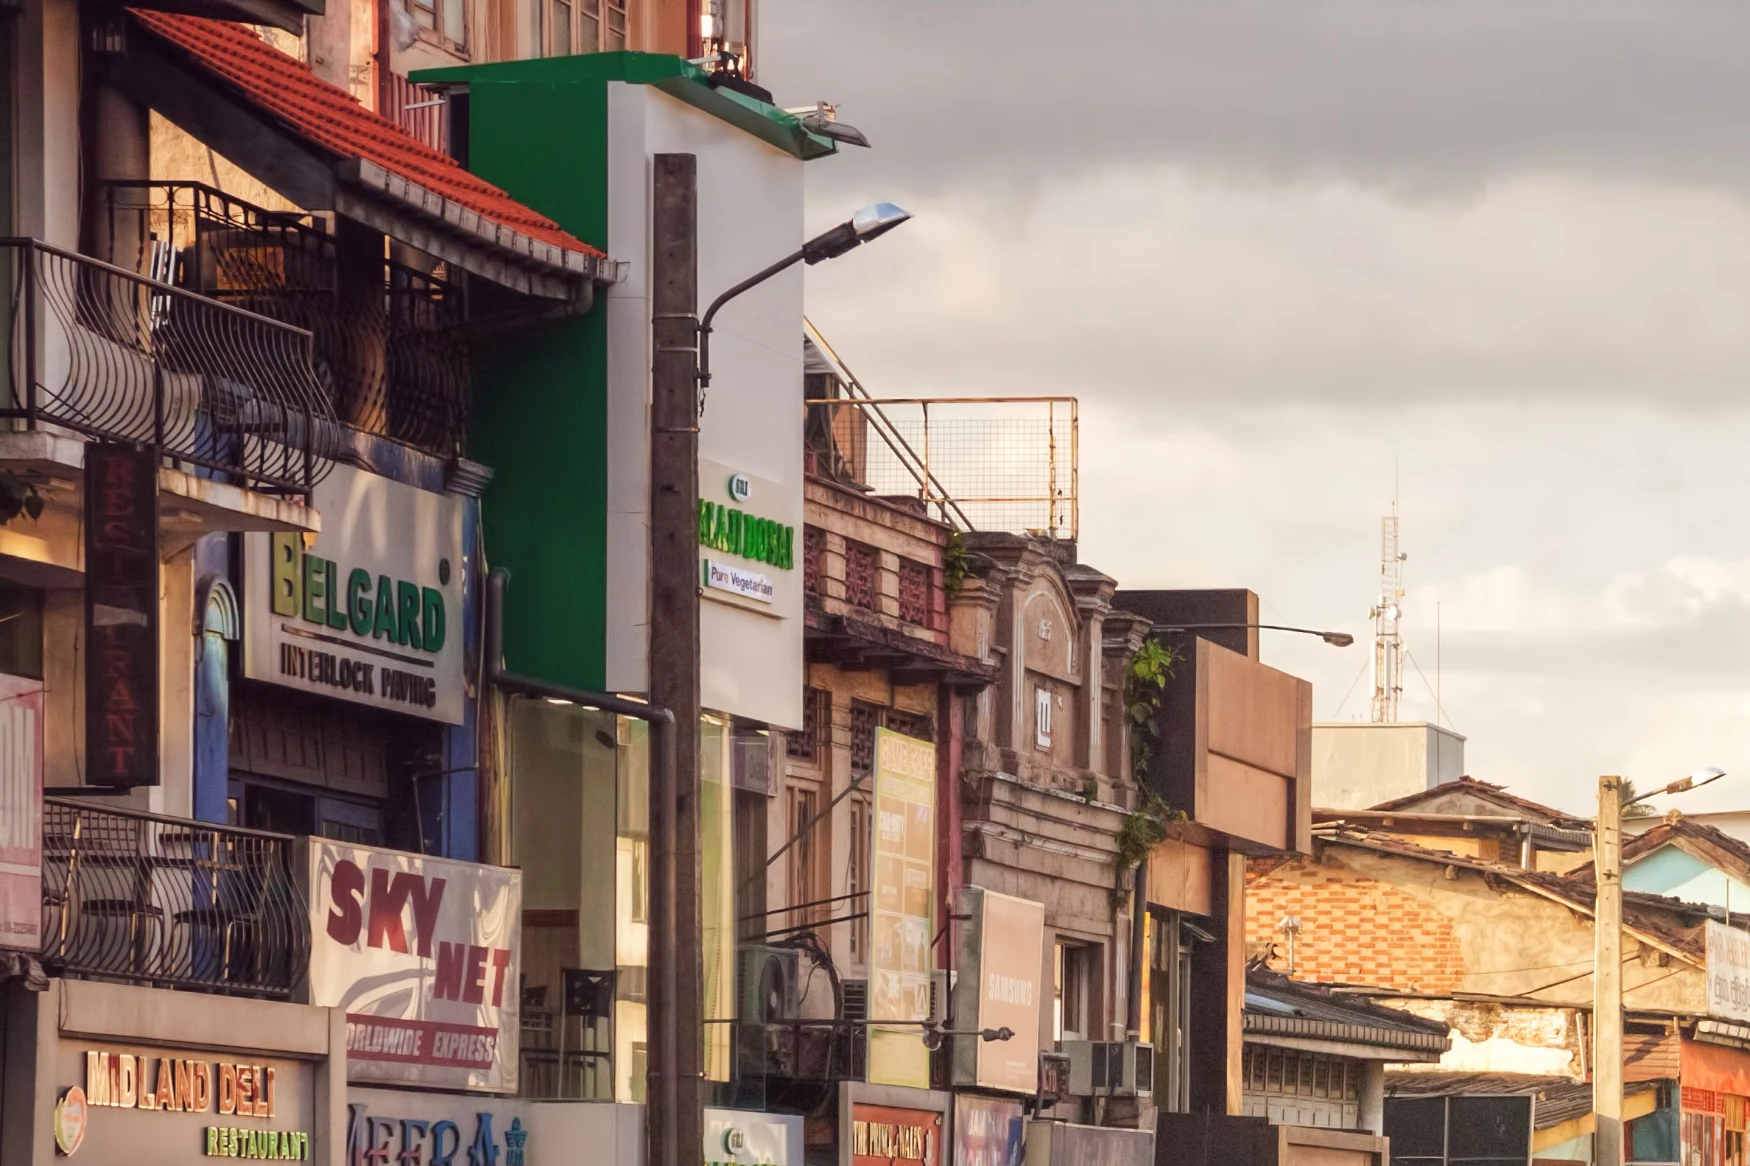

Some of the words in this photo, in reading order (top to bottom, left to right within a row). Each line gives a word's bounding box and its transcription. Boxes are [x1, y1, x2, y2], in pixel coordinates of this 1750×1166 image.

[270, 532, 446, 653] BELGARD
[711, 566, 730, 583] Pure
[730, 572, 774, 597] Vegetarian
[281, 643, 375, 695] INTERLOCK
[326, 859, 446, 957] SKY
[433, 941, 511, 1007] NET
[347, 1021, 422, 1057] ORLDWIDE
[432, 1029, 495, 1064] EXPRESS
[86, 1050, 212, 1113] MIDLAND
[219, 1062, 276, 1118] DELI
[206, 1126, 310, 1161] RESTAURANT
